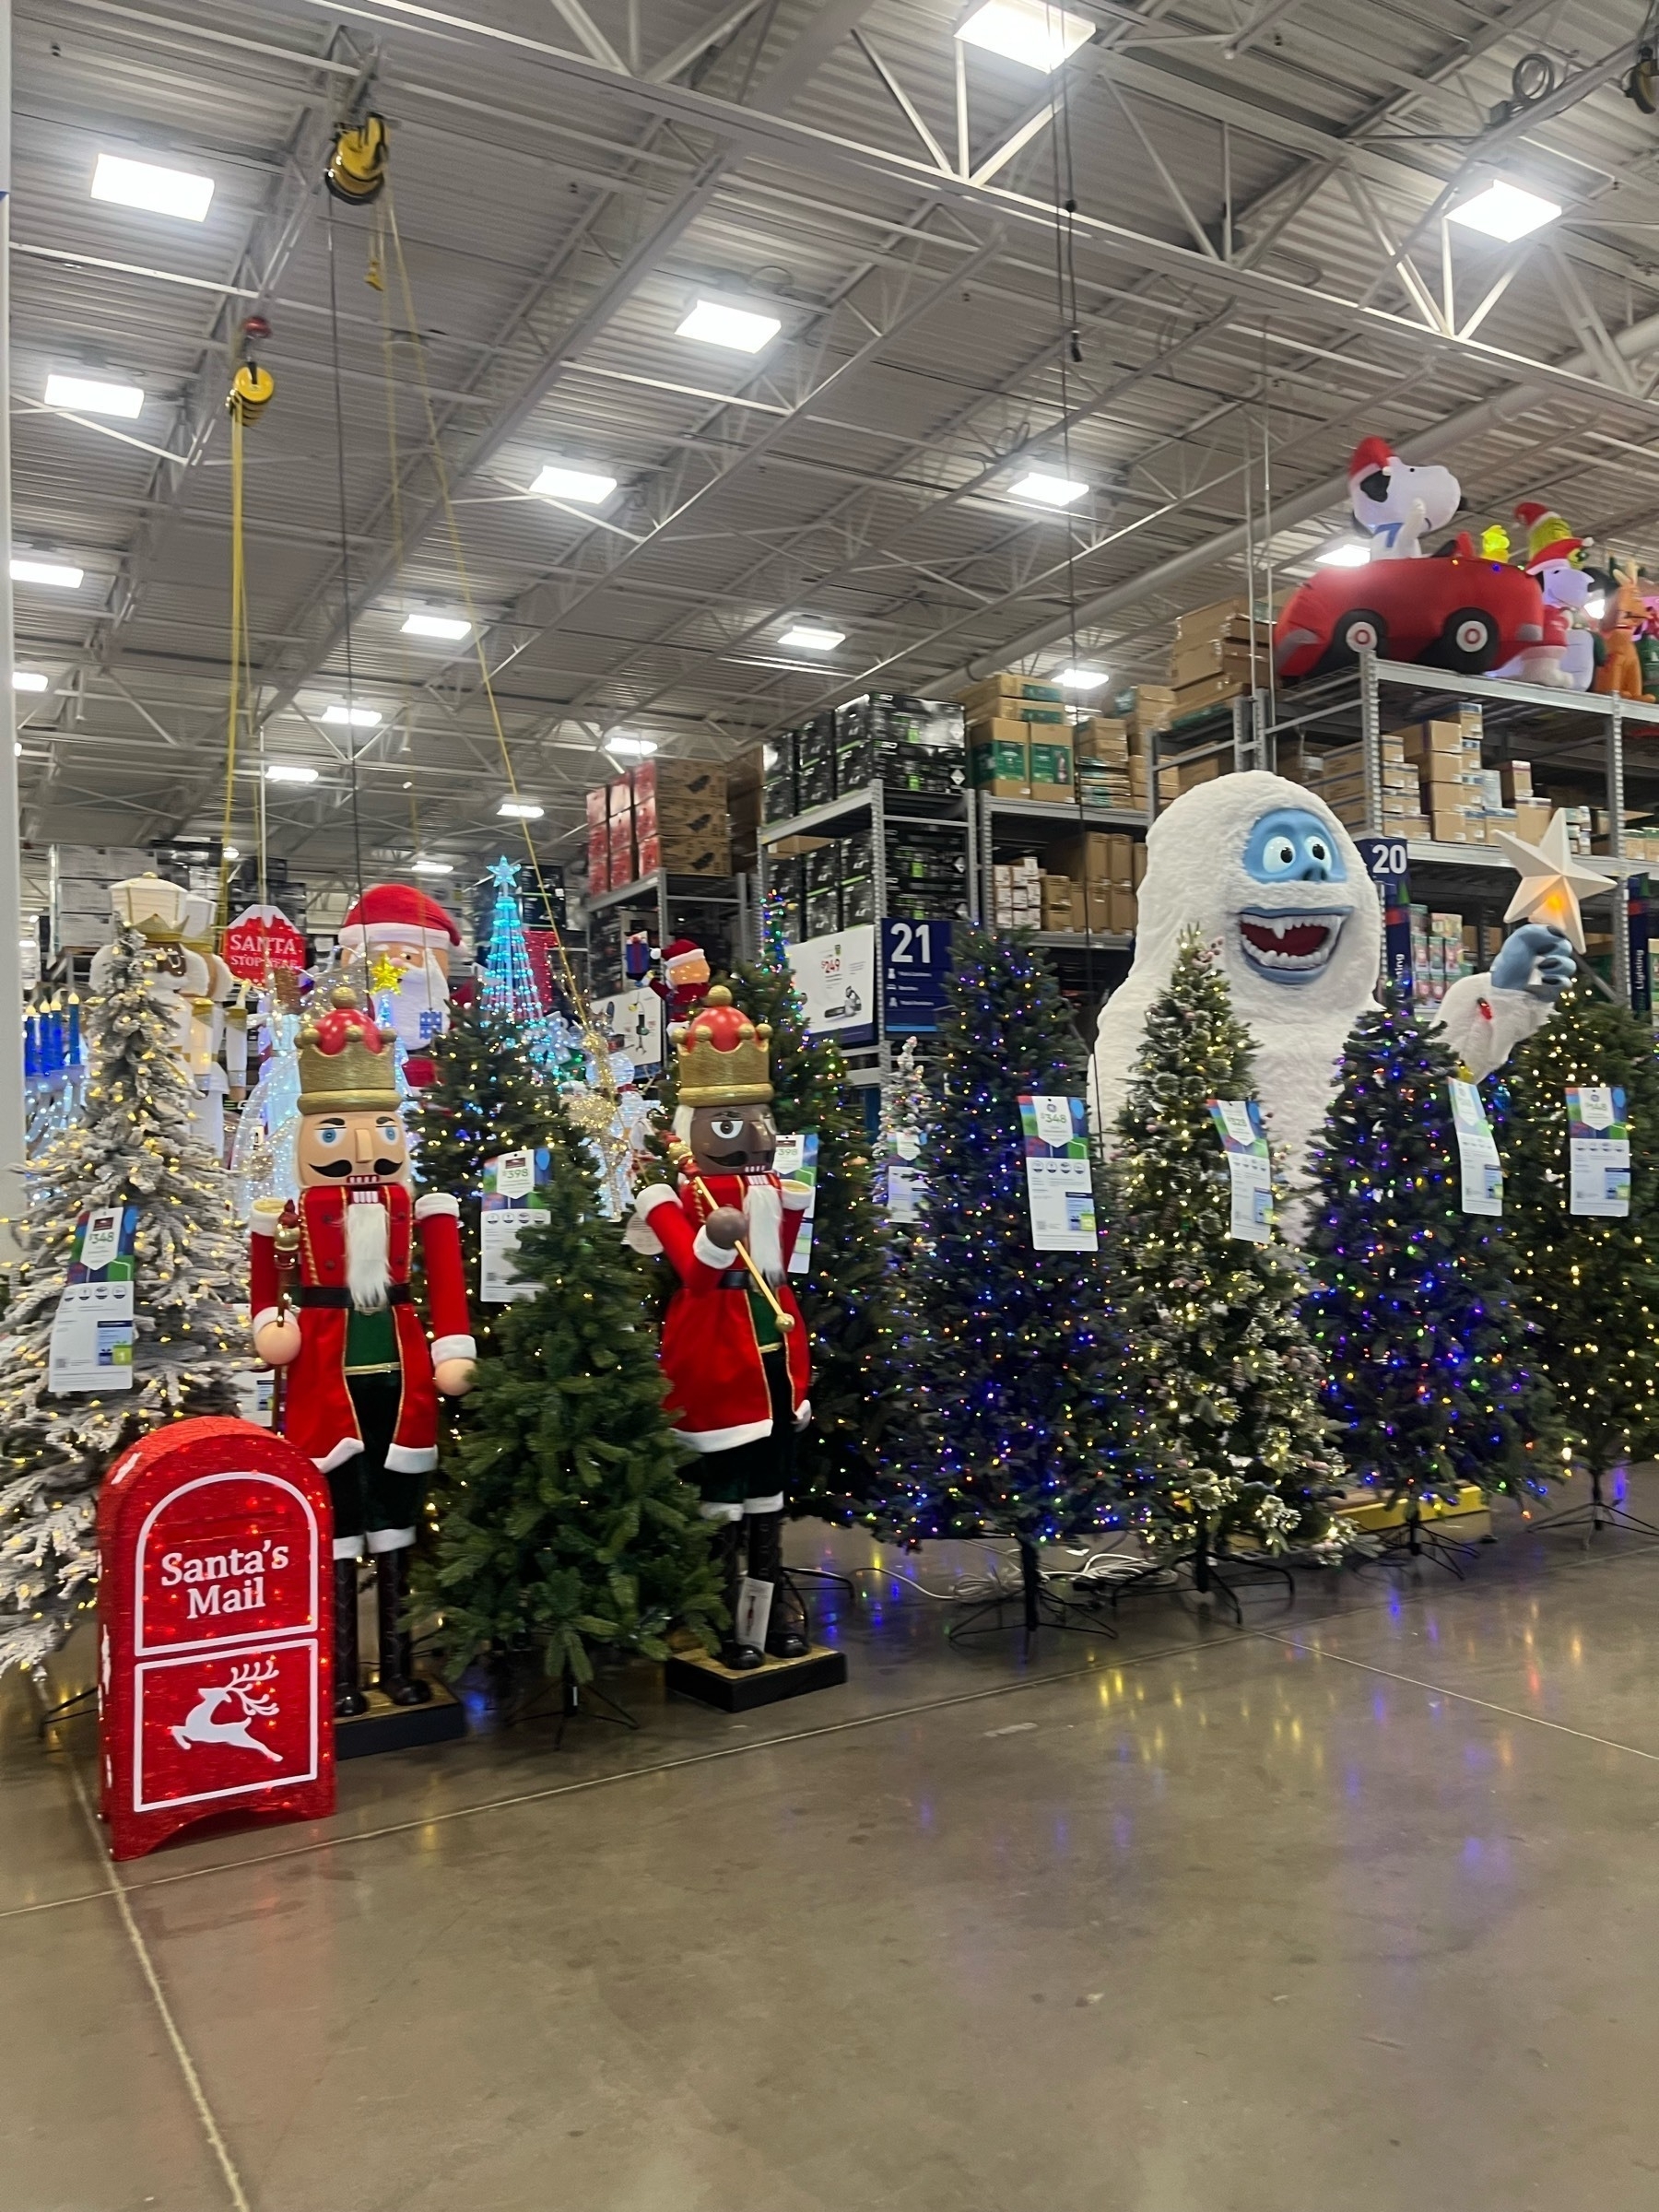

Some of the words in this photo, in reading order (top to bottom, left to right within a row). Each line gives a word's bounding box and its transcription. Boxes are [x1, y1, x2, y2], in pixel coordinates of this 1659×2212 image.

[1371, 843, 1407, 874] 20
[229, 934, 297, 955] SANTA
[230, 955, 262, 966] STOP
[890, 923, 931, 963] 21
[821, 959, 841, 973] $249
[1634, 949, 1646, 990] Lighting
[160, 1539, 289, 1588] Santa’s
[186, 1576, 265, 1619] Mail
